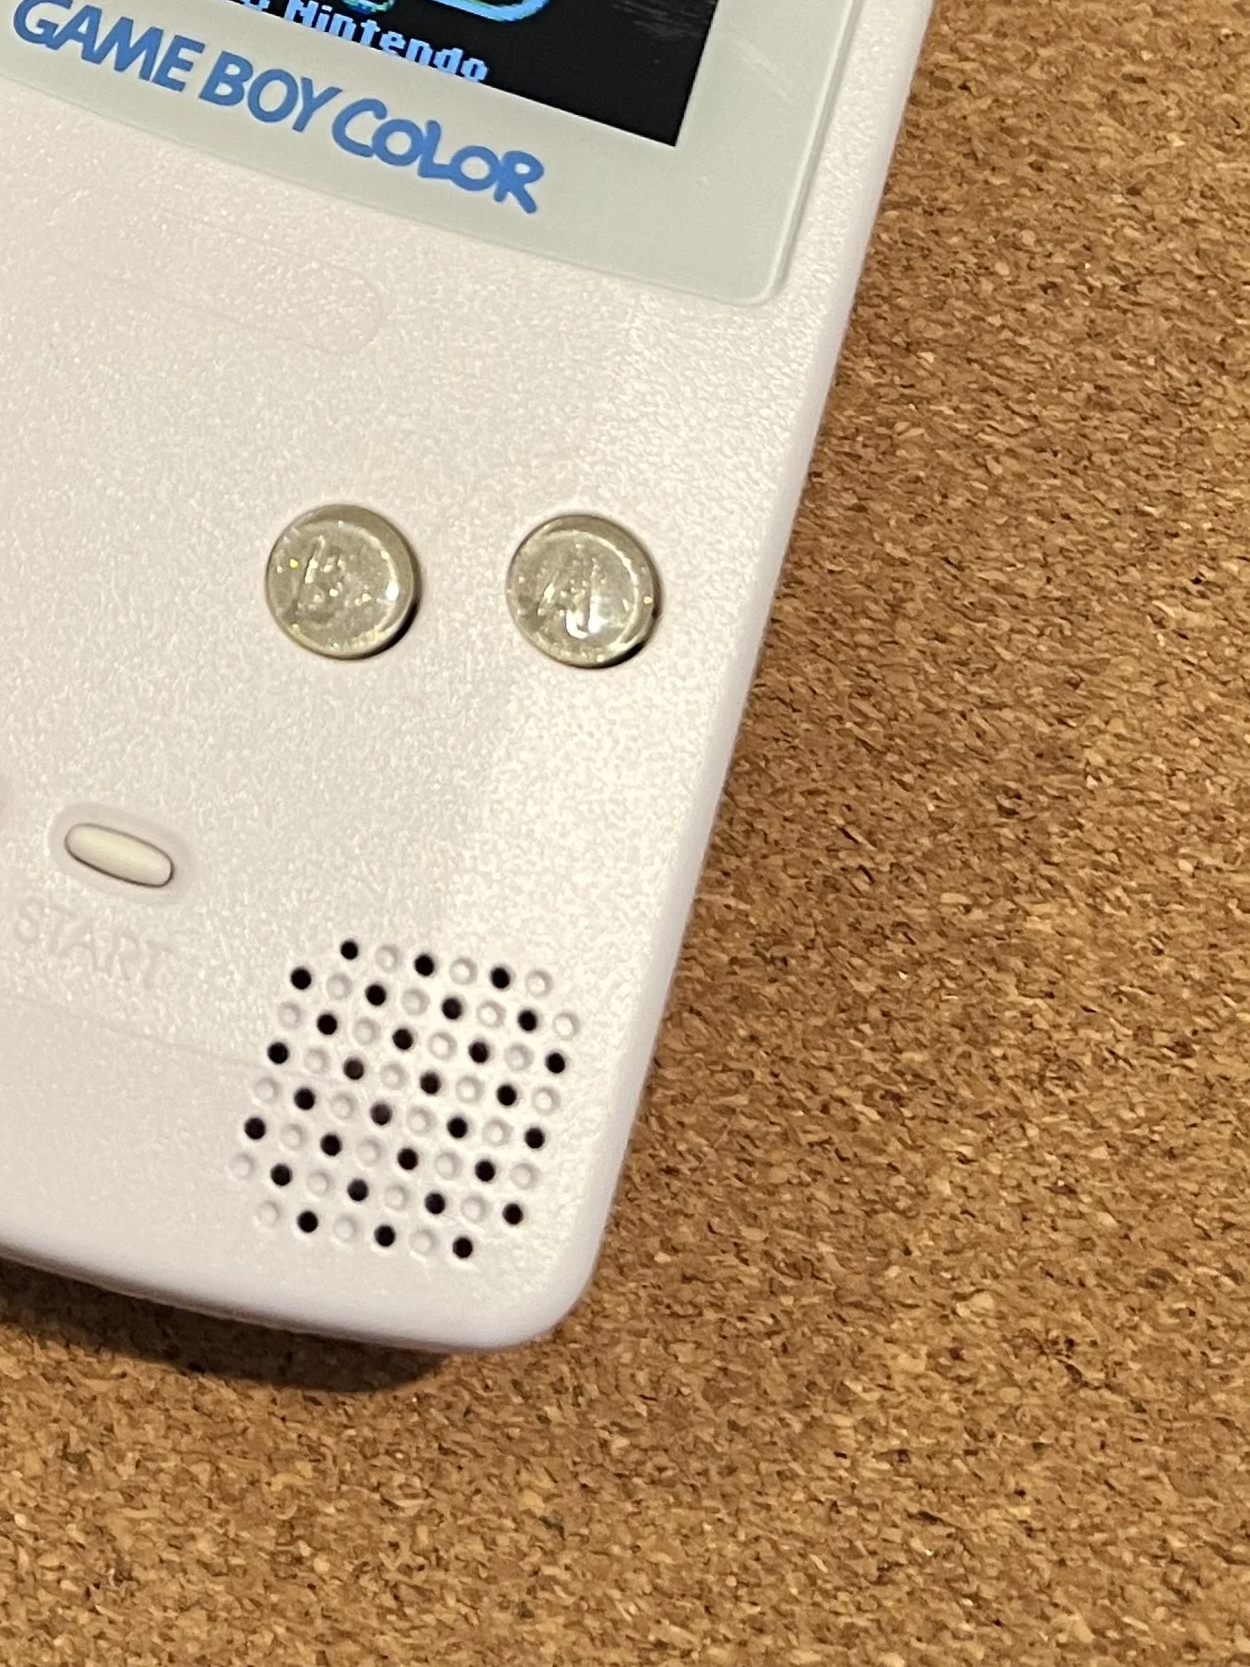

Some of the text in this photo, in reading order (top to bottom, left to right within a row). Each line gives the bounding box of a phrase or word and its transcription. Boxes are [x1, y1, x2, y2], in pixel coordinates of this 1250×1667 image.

[199, 51, 343, 133] BOY
[331, 98, 545, 214] COLOR
[14, 894, 174, 990] START
